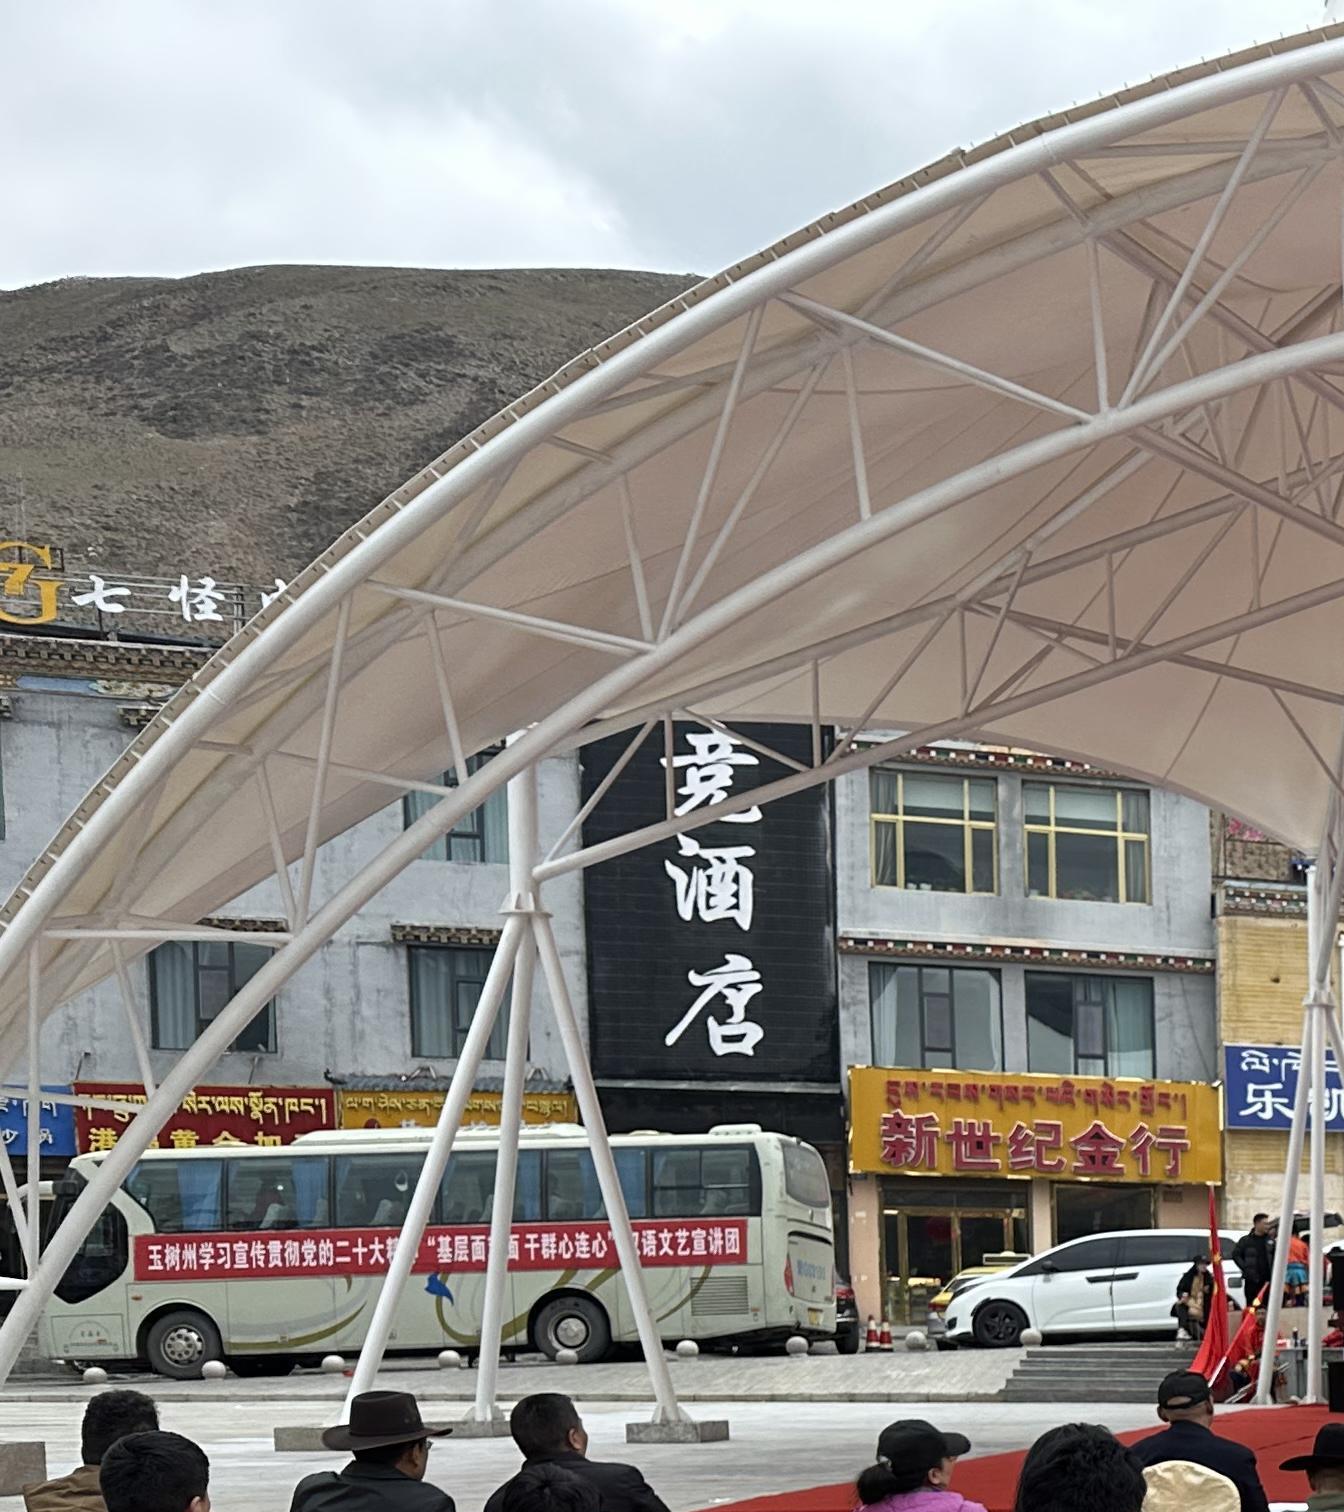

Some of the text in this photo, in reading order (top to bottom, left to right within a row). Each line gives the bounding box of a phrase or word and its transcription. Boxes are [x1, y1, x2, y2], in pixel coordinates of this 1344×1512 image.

[880, 1108, 1190, 1177] 新世纪金行
